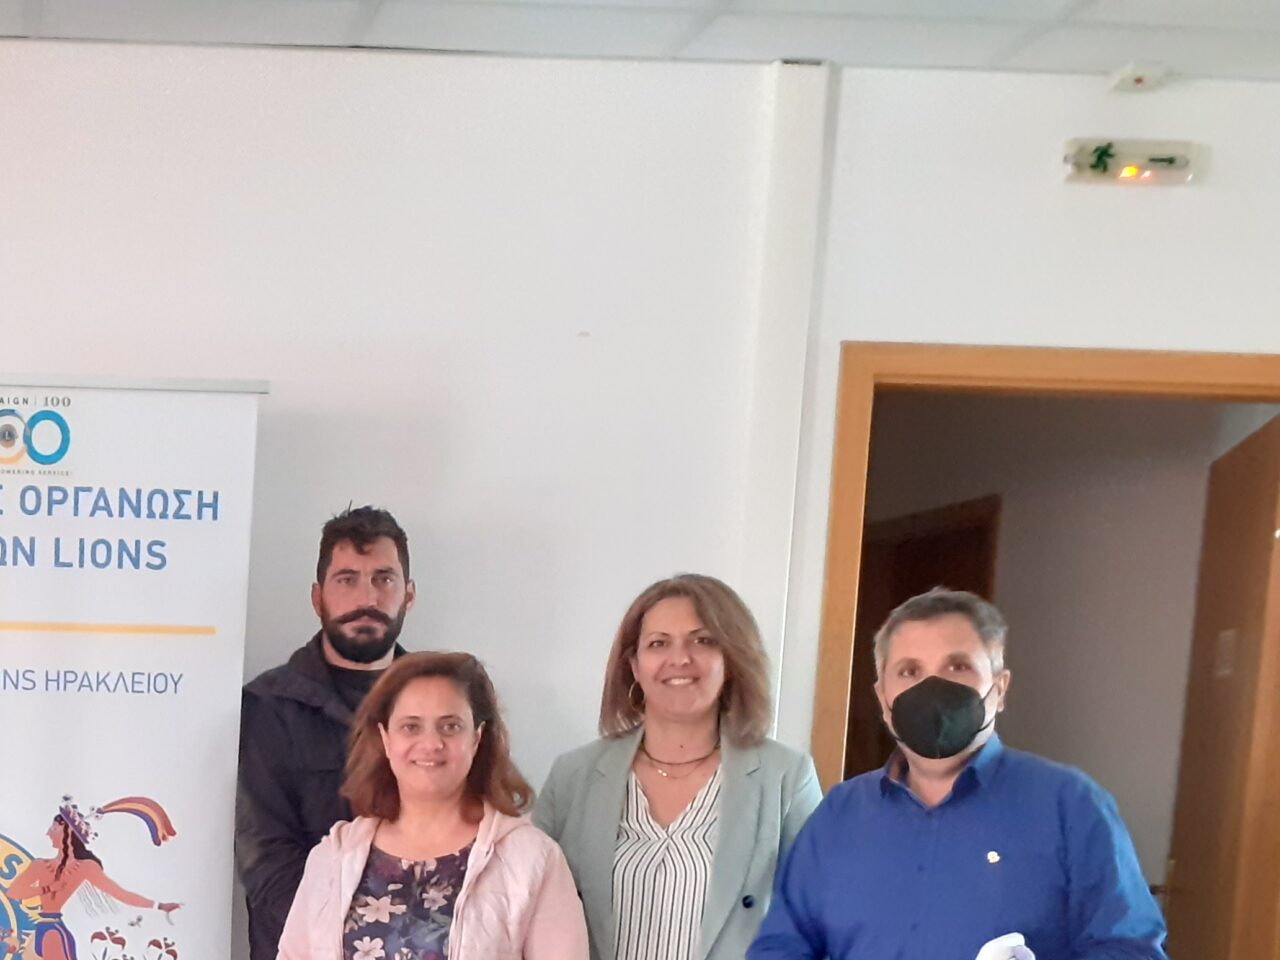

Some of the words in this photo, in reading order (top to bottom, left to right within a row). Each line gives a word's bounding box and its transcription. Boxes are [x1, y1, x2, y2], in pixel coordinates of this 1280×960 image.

[43, 396, 71, 407] 100
[19, 485, 219, 521] ΟΡΓΑΝΩΣΗ
[53, 537, 168, 571] LIONS
[45, 669, 183, 694] ΗΡΑΚΛΕΙΟΥ
